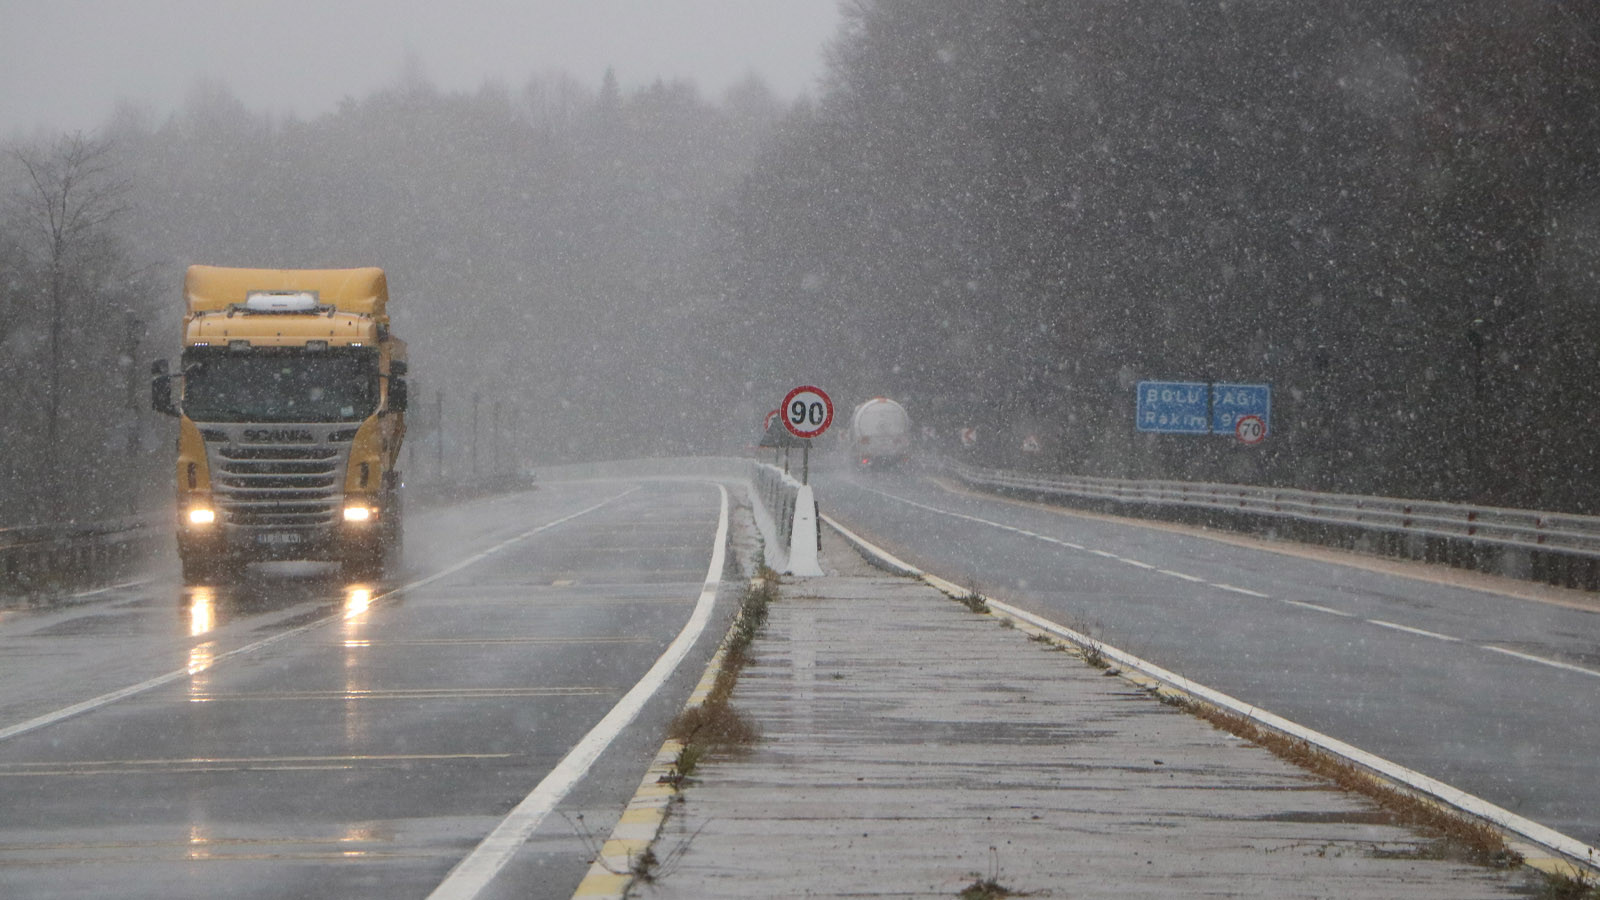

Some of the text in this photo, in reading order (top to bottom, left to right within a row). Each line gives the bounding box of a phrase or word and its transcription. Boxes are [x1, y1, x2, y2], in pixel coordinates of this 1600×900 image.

[1146, 389, 1200, 403] BOLU
[791, 400, 824, 426] 90
[243, 429, 314, 442] SCANIA
[1242, 423, 1261, 437] 70
